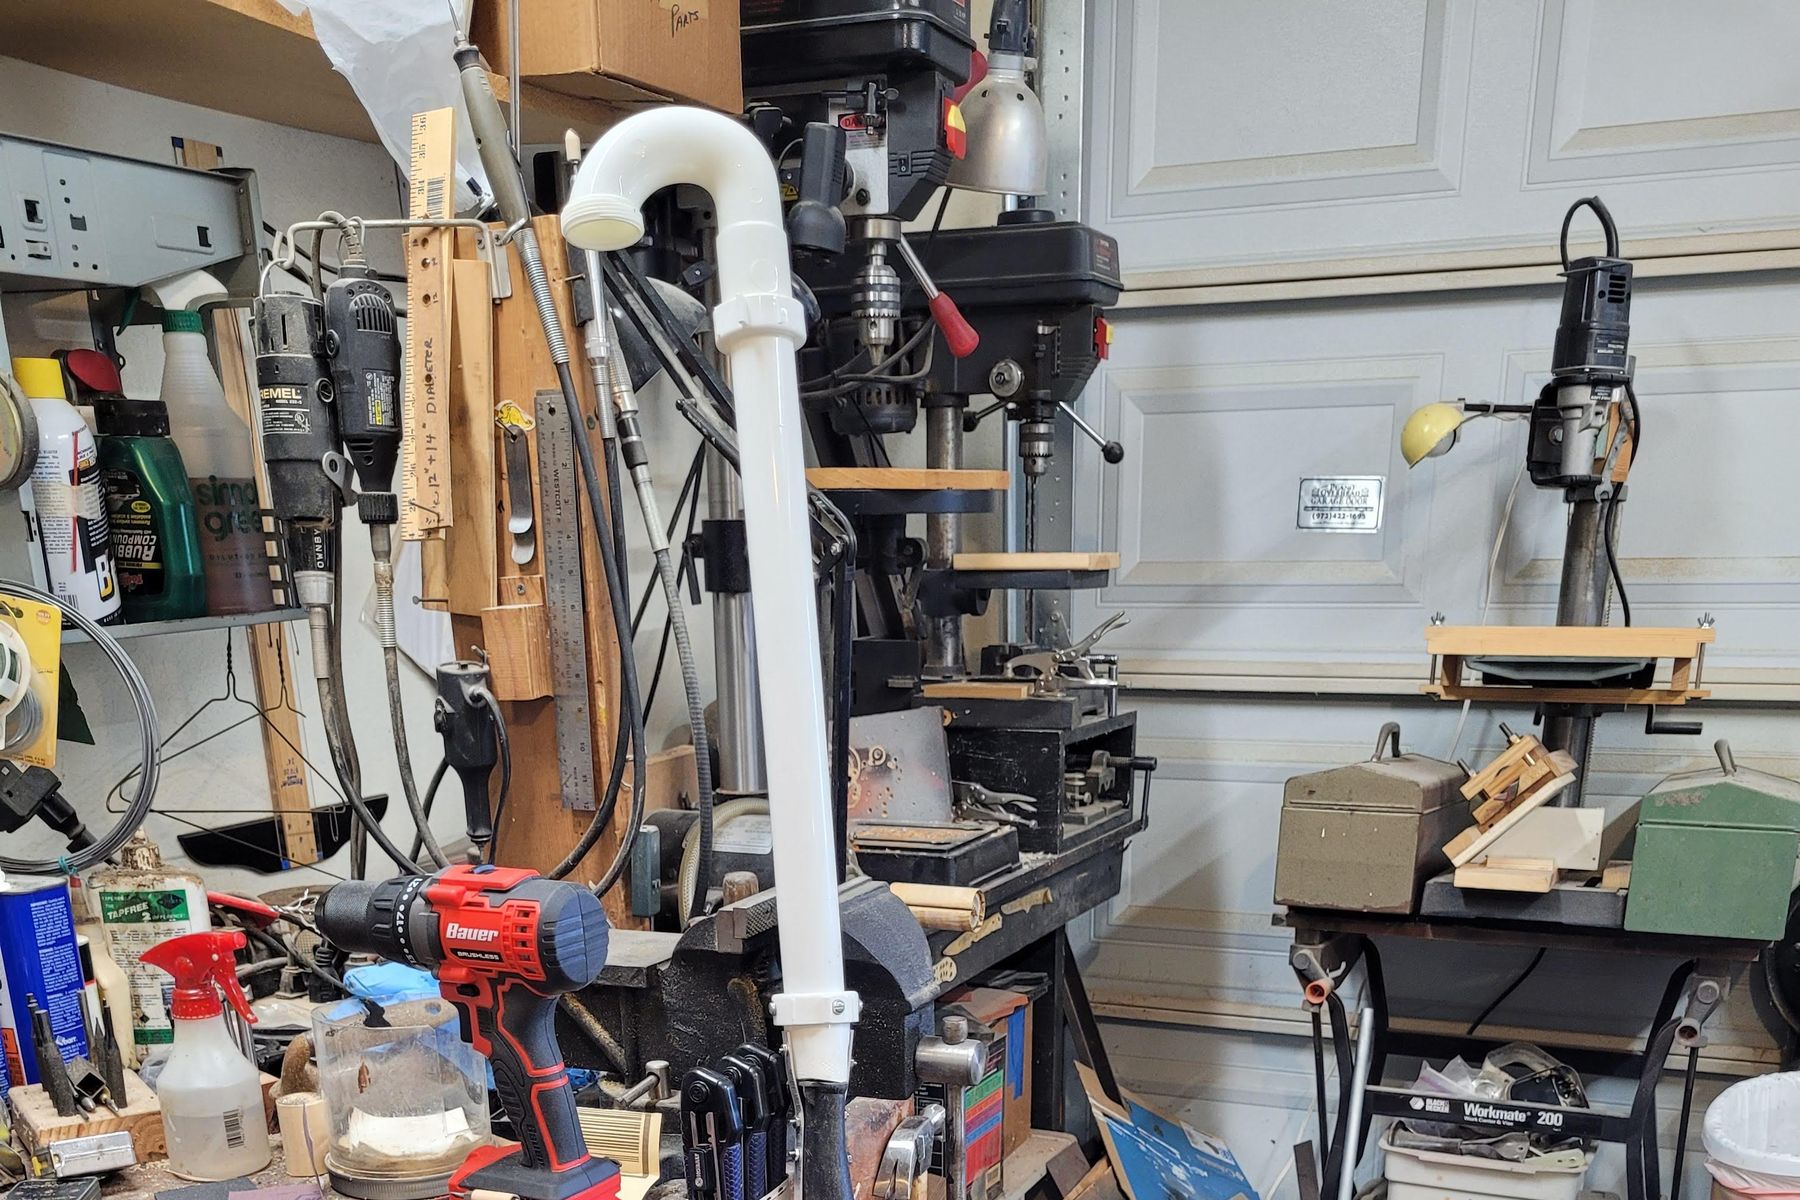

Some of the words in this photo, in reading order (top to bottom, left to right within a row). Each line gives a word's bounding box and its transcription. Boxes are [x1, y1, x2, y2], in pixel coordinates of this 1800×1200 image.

[260, 387, 302, 400] REMEL
[553, 468, 562, 518] WESTCOTT
[1311, 497, 1342, 505] GARAGE
[1345, 497, 1368, 505] DOOR
[204, 510, 262, 542] gree
[113, 535, 157, 545] COMPOUN
[314, 528, 325, 569] OWNBY
[115, 545, 156, 561] RUBBI
[107, 901, 150, 921] TAPFREE
[141, 911, 152, 923] 2
[446, 922, 499, 942] Bauer
[457, 951, 500, 961] BRUSHLESS
[1463, 1102, 1526, 1123] Workmate
[1536, 1111, 1563, 1127] 200
